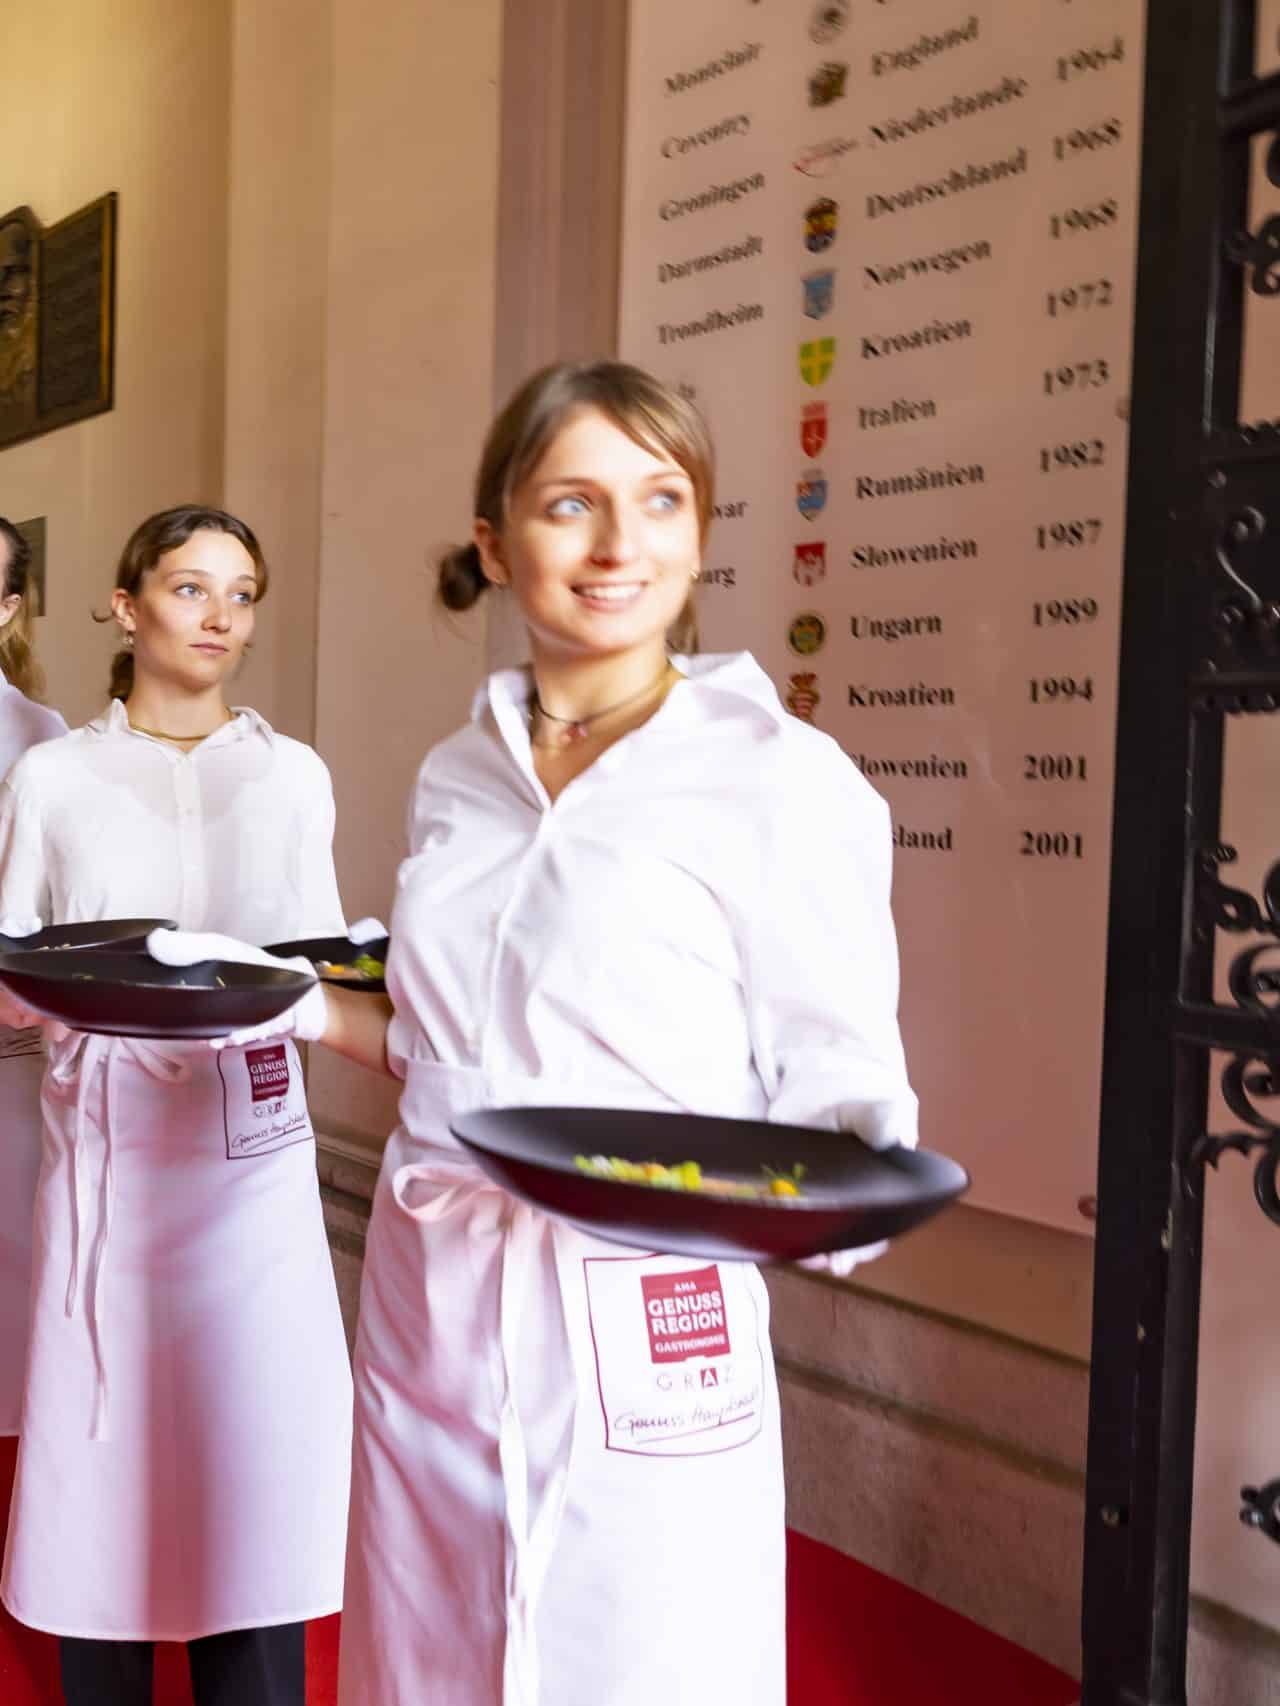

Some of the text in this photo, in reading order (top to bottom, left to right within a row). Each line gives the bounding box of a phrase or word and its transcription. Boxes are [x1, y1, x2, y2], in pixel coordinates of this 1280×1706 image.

[872, 15, 979, 76] England
[658, 35, 1124, 221] Groningen Niederlande 1964
[658, 235, 763, 284] Darmstadt
[866, 148, 1028, 219] Deutschland
[658, 303, 764, 345] Trondheim
[864, 239, 992, 289] Norwegen
[861, 278, 1113, 360] Kroatien 1972
[858, 359, 1110, 430] Italien 1973
[855, 437, 1106, 499] Rumänien 1982
[851, 517, 1103, 569] Slowenien 1987
[849, 597, 1100, 642] Ungarn 1989
[847, 676, 1095, 708] Kroatien 1994
[852, 753, 1088, 781] lowenien 2001
[1019, 830, 1084, 860] 2001
[647, 1290, 723, 1319] GENUSS
[674, 1280, 697, 1294] AMA
[650, 1308, 725, 1337] REGION
